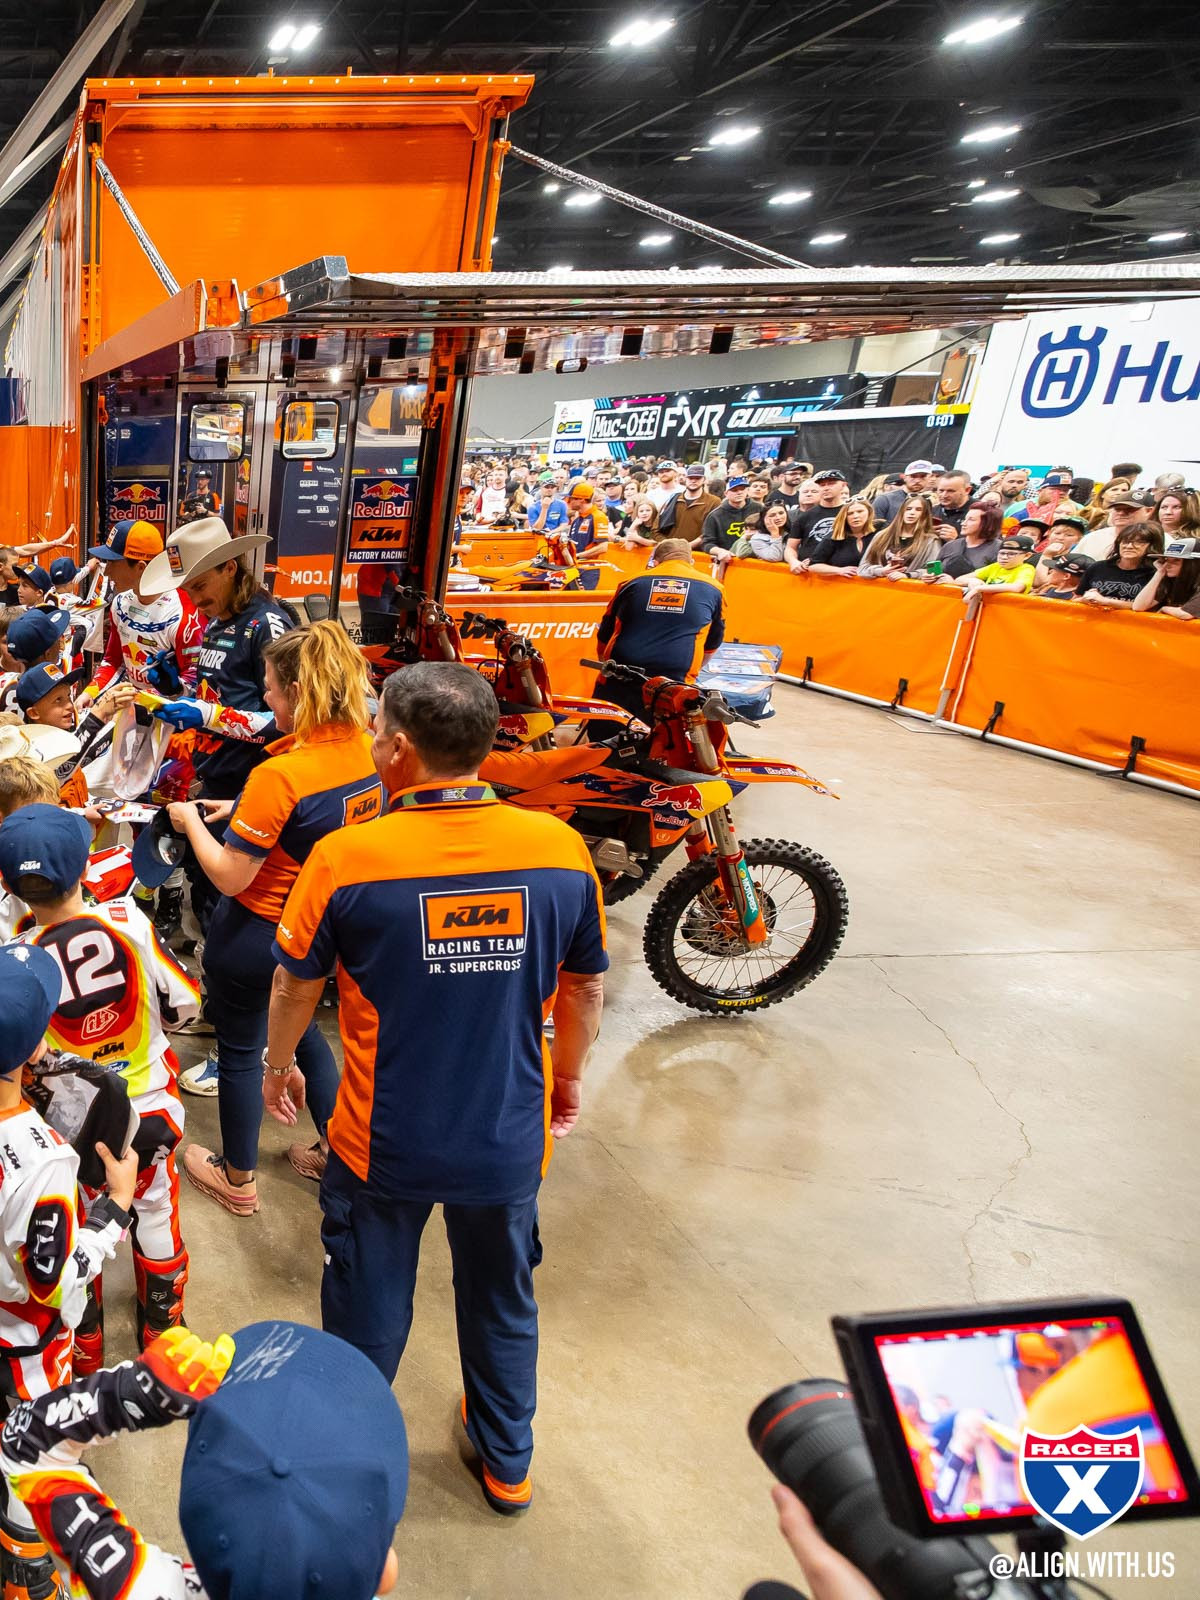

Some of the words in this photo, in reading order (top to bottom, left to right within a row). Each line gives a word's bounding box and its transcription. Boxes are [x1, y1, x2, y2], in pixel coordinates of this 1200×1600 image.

[1038, 356, 1082, 402] H
[592, 411, 657, 439] Muc-Off
[661, 404, 727, 438] FXR
[109, 504, 136, 521] Red
[136, 504, 166, 521] Bull
[353, 502, 384, 518] Red
[384, 501, 413, 518] Bull
[358, 527, 402, 541] KTM
[349, 551, 380, 560] FACTORY
[381, 550, 407, 560] RACING
[351, 796, 377, 820] KTM
[19, 860, 41, 871] KTM
[741, 877, 758, 914] MOTOREX
[441, 903, 511, 930] KTM
[427, 940, 482, 956] RACING
[488, 937, 525, 953] TEAM
[44, 929, 126, 1005] 12
[429, 962, 446, 974] JR.
[450, 958, 522, 974] SUPERCROSS
[717, 995, 767, 1007] DUNLOP
[92, 1041, 125, 1060] KTM
[3, 1143, 21, 1170] KTM
[44, 1390, 100, 1430] KTM
